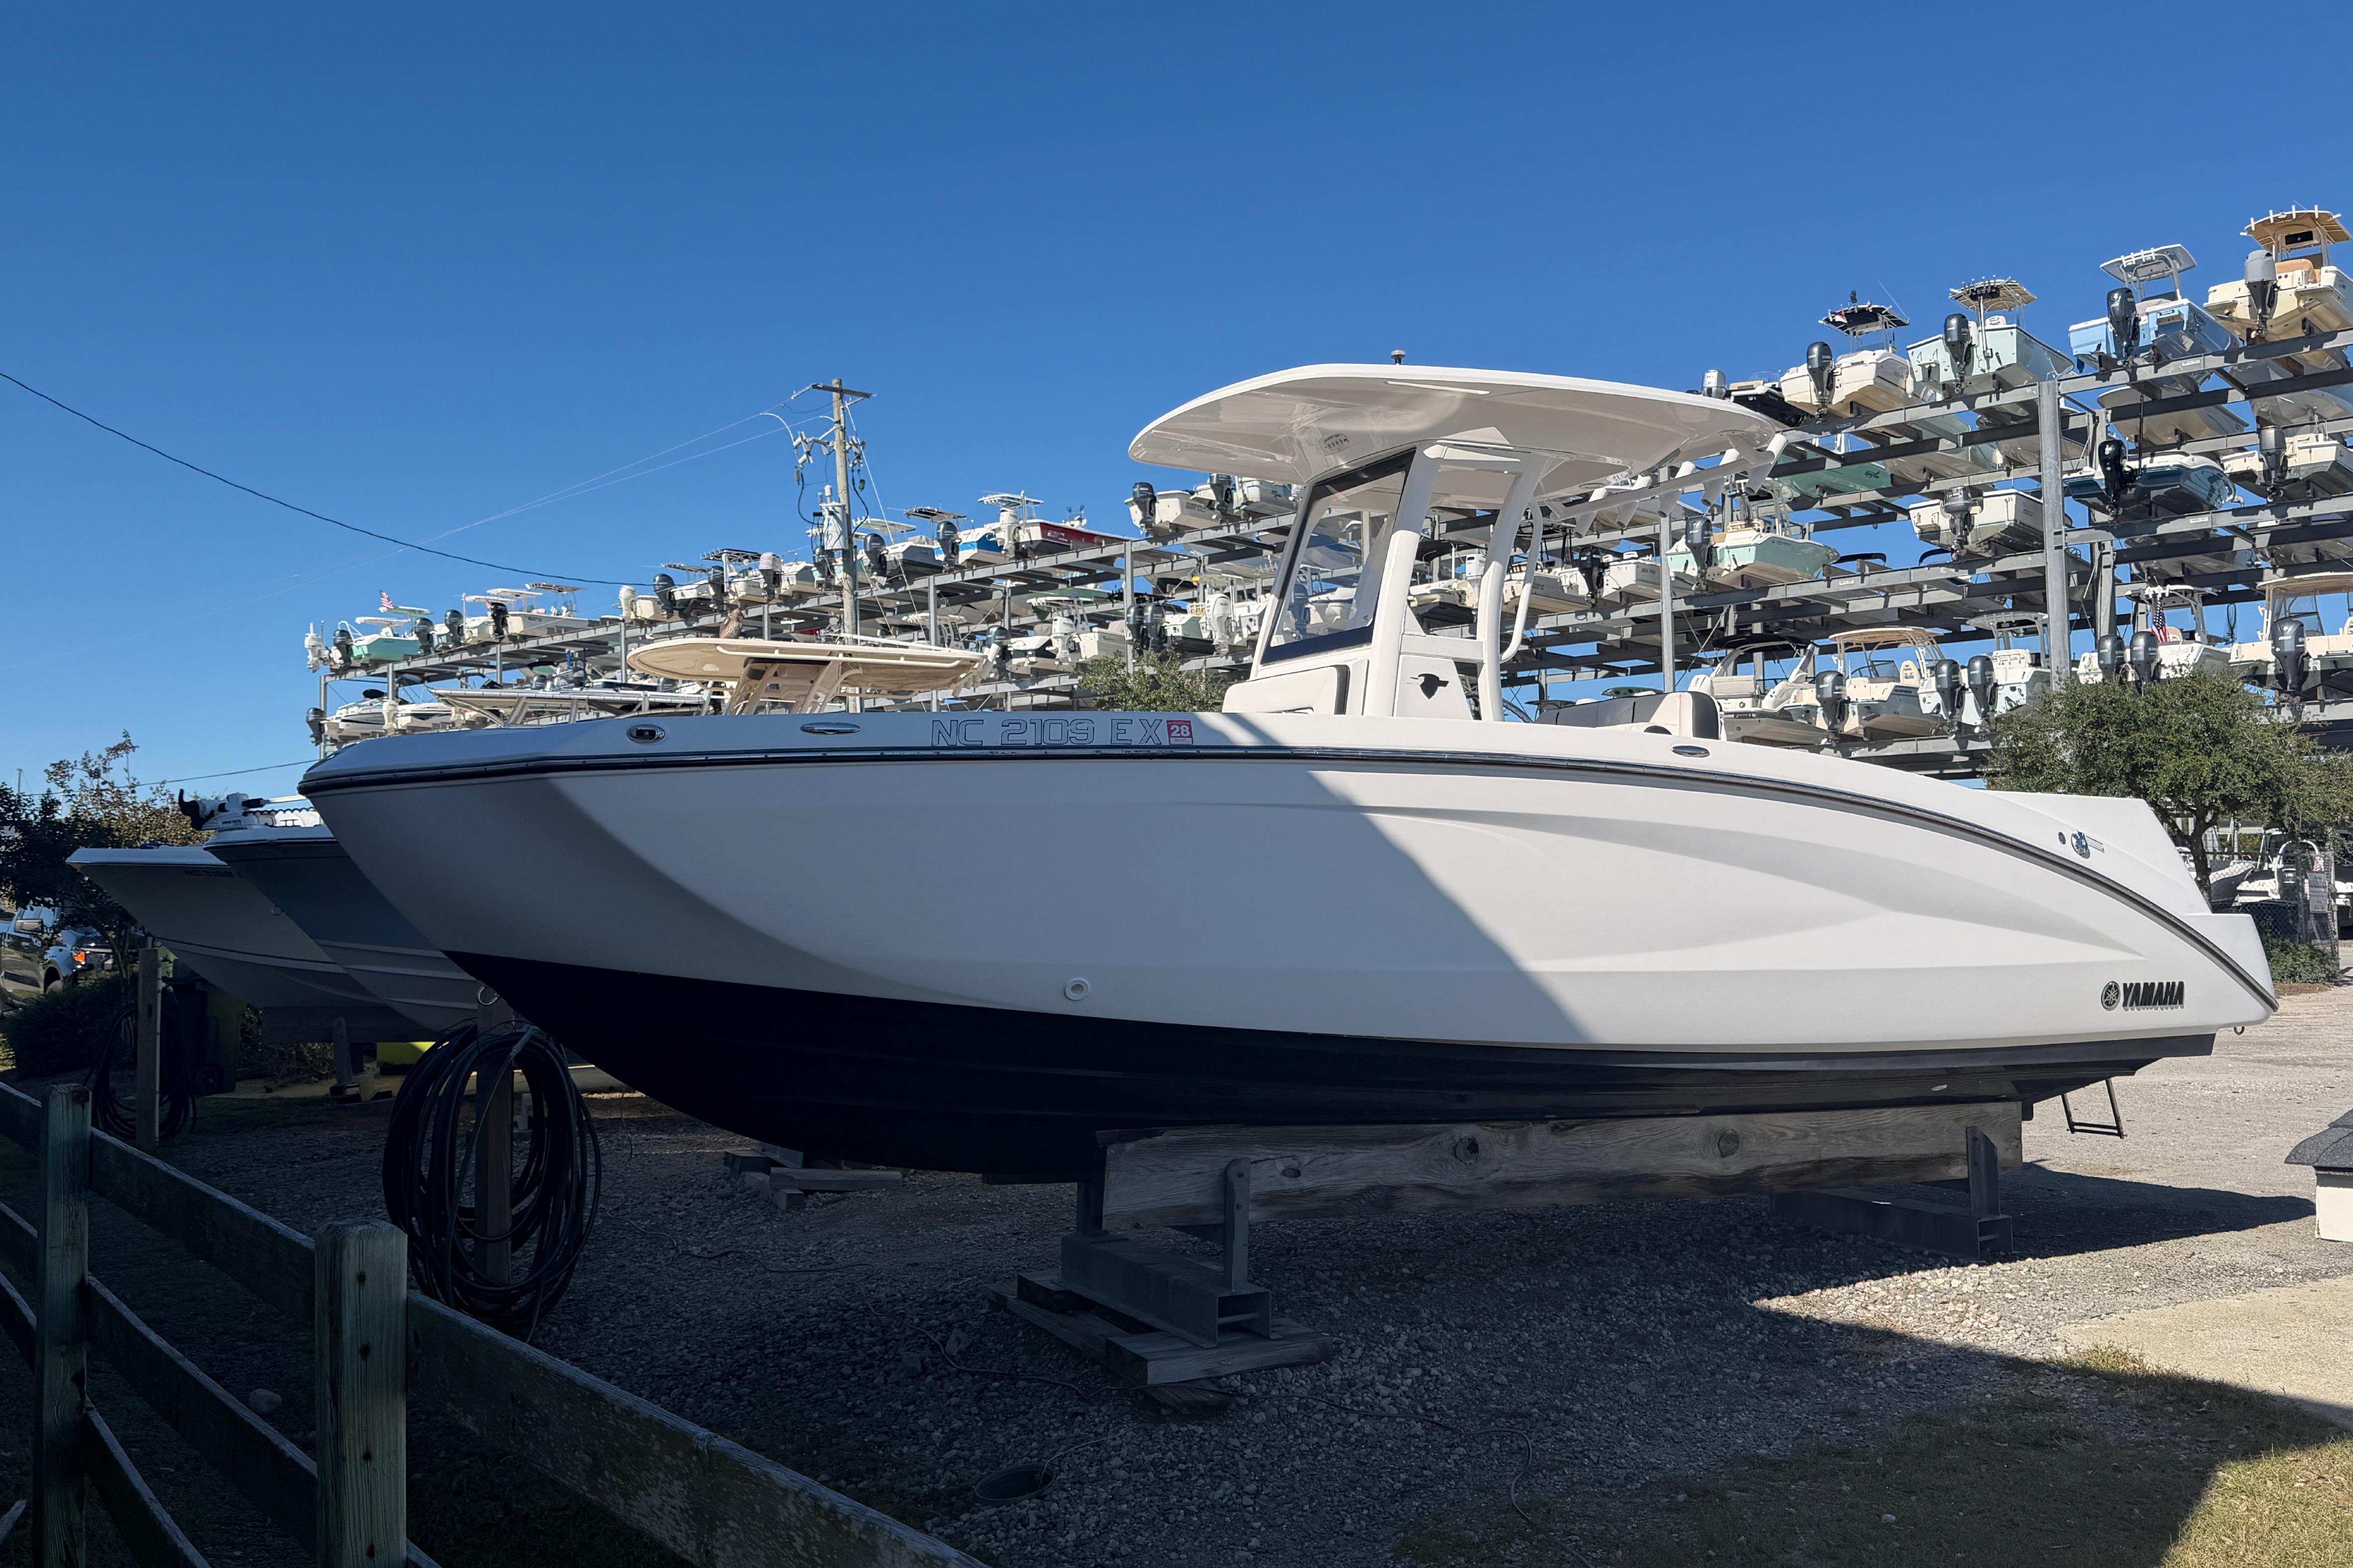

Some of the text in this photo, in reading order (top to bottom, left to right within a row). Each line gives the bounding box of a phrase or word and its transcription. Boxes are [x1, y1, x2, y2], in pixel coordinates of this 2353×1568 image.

[931, 719, 1162, 746] NC 2109 EX
[1170, 725, 1190, 737] 28
[2122, 981, 2184, 1008] YAMAHA
